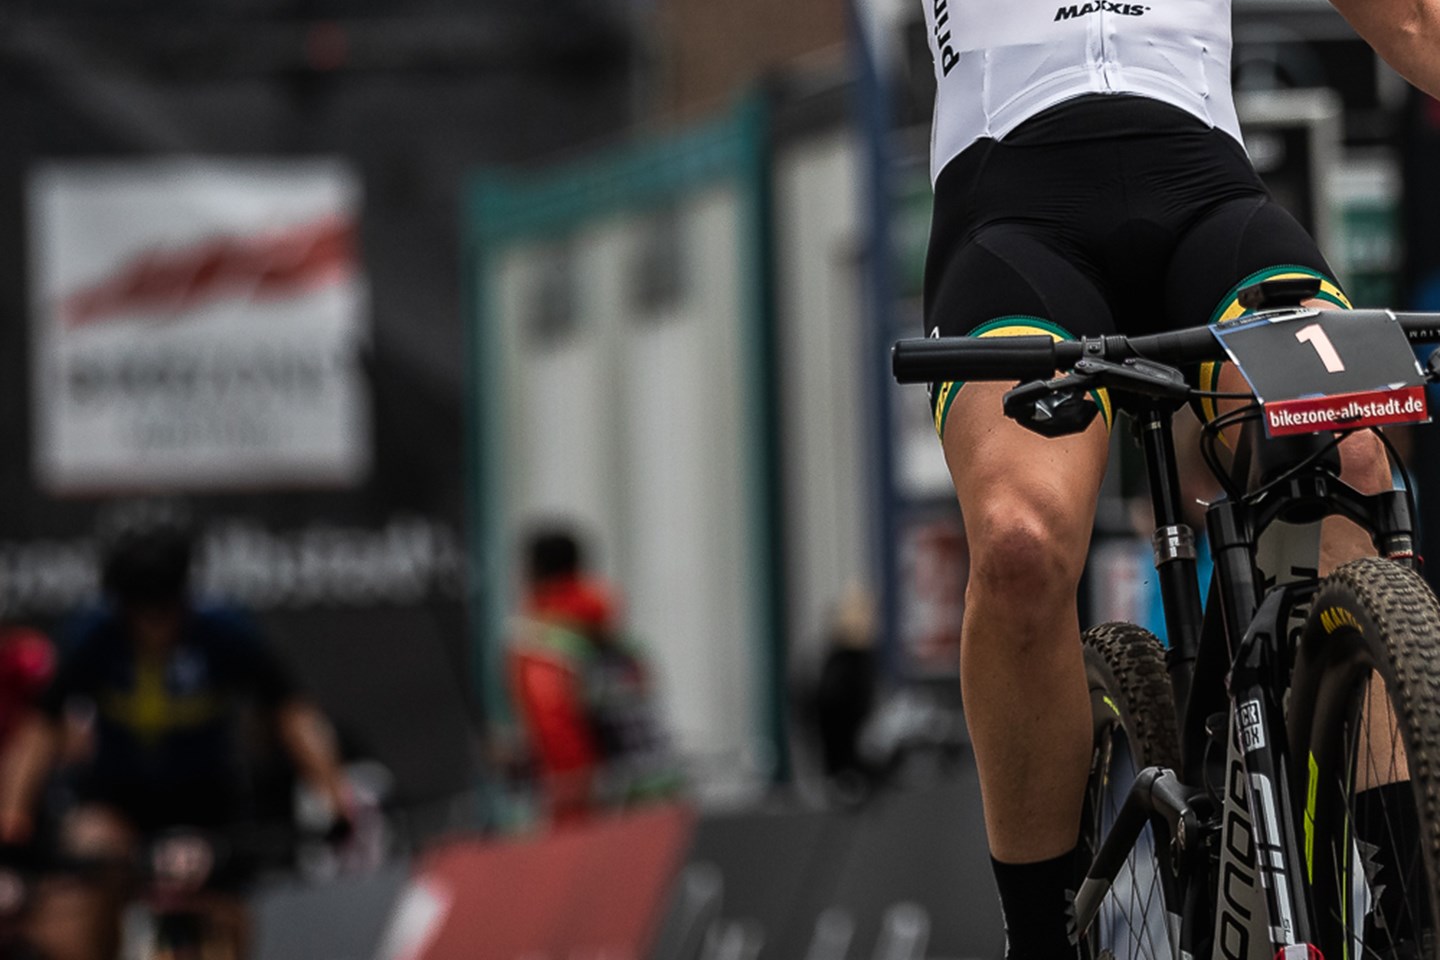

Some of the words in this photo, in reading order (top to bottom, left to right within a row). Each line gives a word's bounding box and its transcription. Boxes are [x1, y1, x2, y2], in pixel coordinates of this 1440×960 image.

[1054, 0, 1145, 22] MAXXIS
[1295, 324, 1346, 373] 1
[1269, 397, 1424, 428] bikezone-albstadt.de
